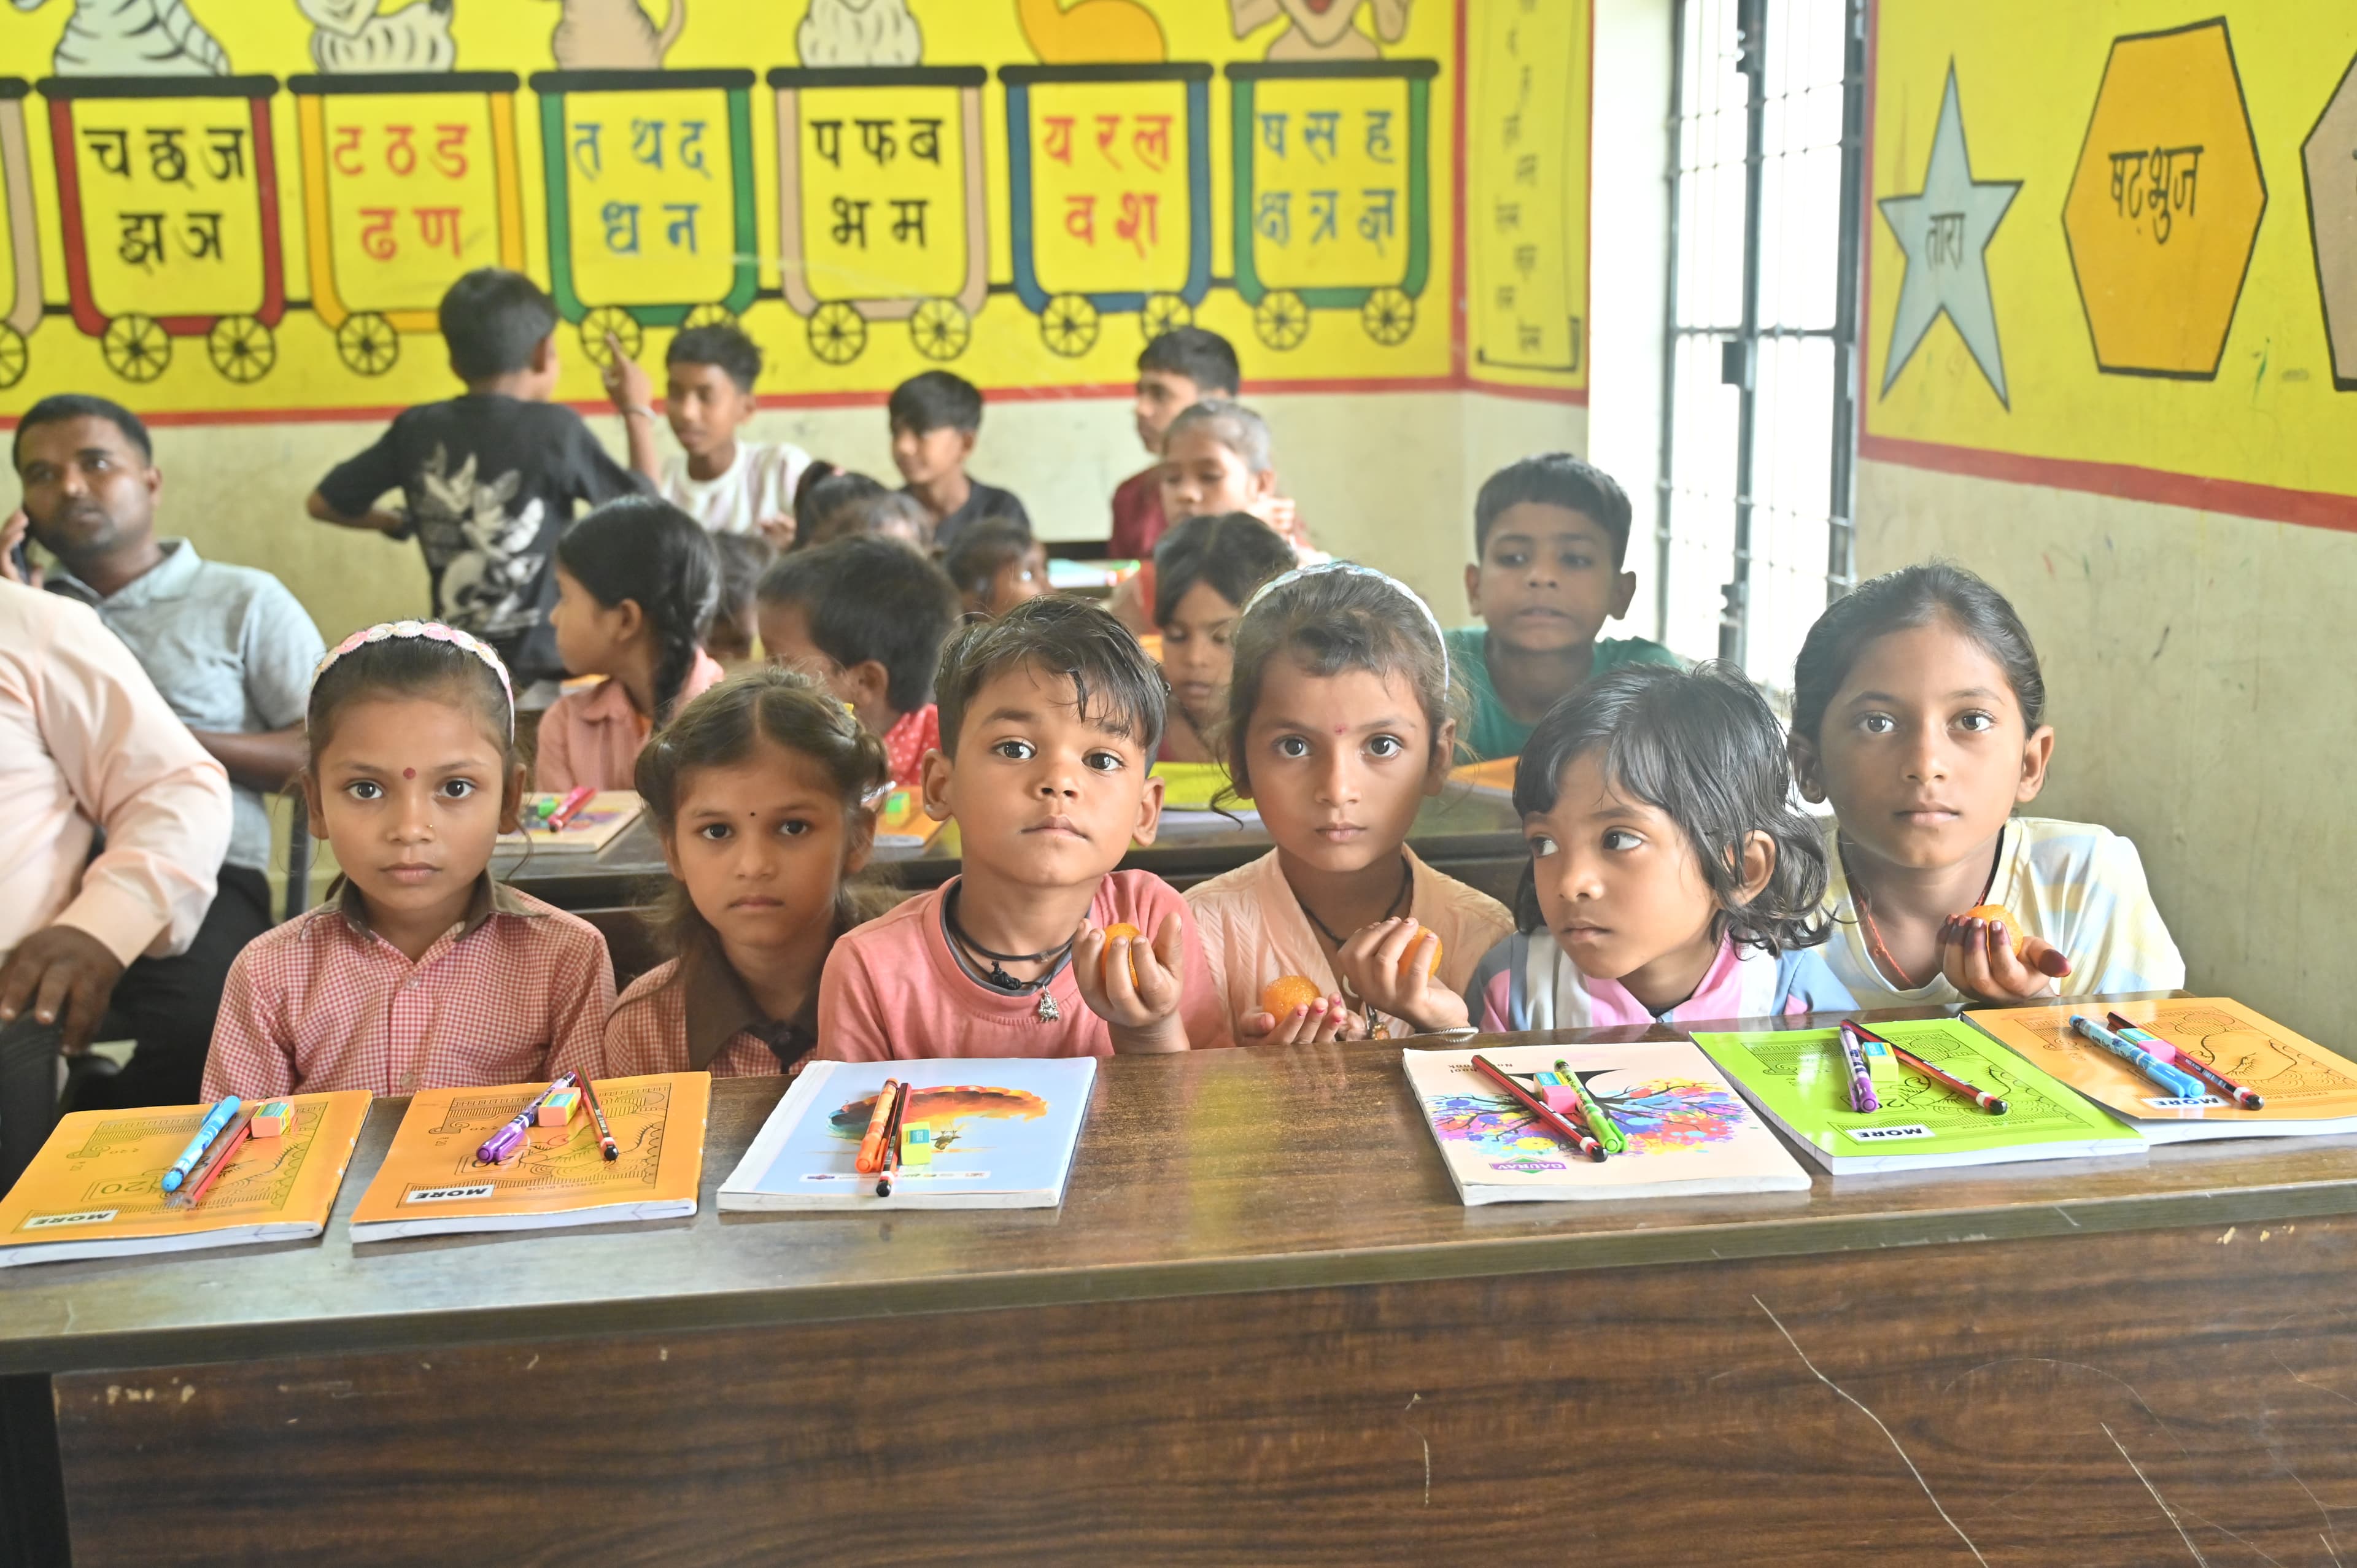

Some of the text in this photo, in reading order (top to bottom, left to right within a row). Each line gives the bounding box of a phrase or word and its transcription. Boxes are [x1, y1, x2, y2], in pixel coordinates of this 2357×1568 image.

[82, 128, 131, 179] च
[204, 126, 246, 182] ज
[333, 124, 471, 179] ट ठ ड
[573, 118, 710, 181] त थ द
[808, 118, 944, 169] प फ ब
[1042, 114, 1174, 172] य र ल
[1364, 110, 1396, 164] ह
[118, 211, 224, 274] झ ञ
[358, 207, 464, 262] ढ ण
[662, 202, 702, 253] न
[831, 195, 929, 250] भ म
[1064, 191, 1159, 261] व श
[1925, 212, 1967, 271] तारा
[2153, 1097, 2219, 1106] MORE
[1857, 1128, 1922, 1138] MORE
[101, 1181, 148, 1194] 20
[415, 1188, 488, 1199] MORE
[33, 1212, 111, 1226] MORE
